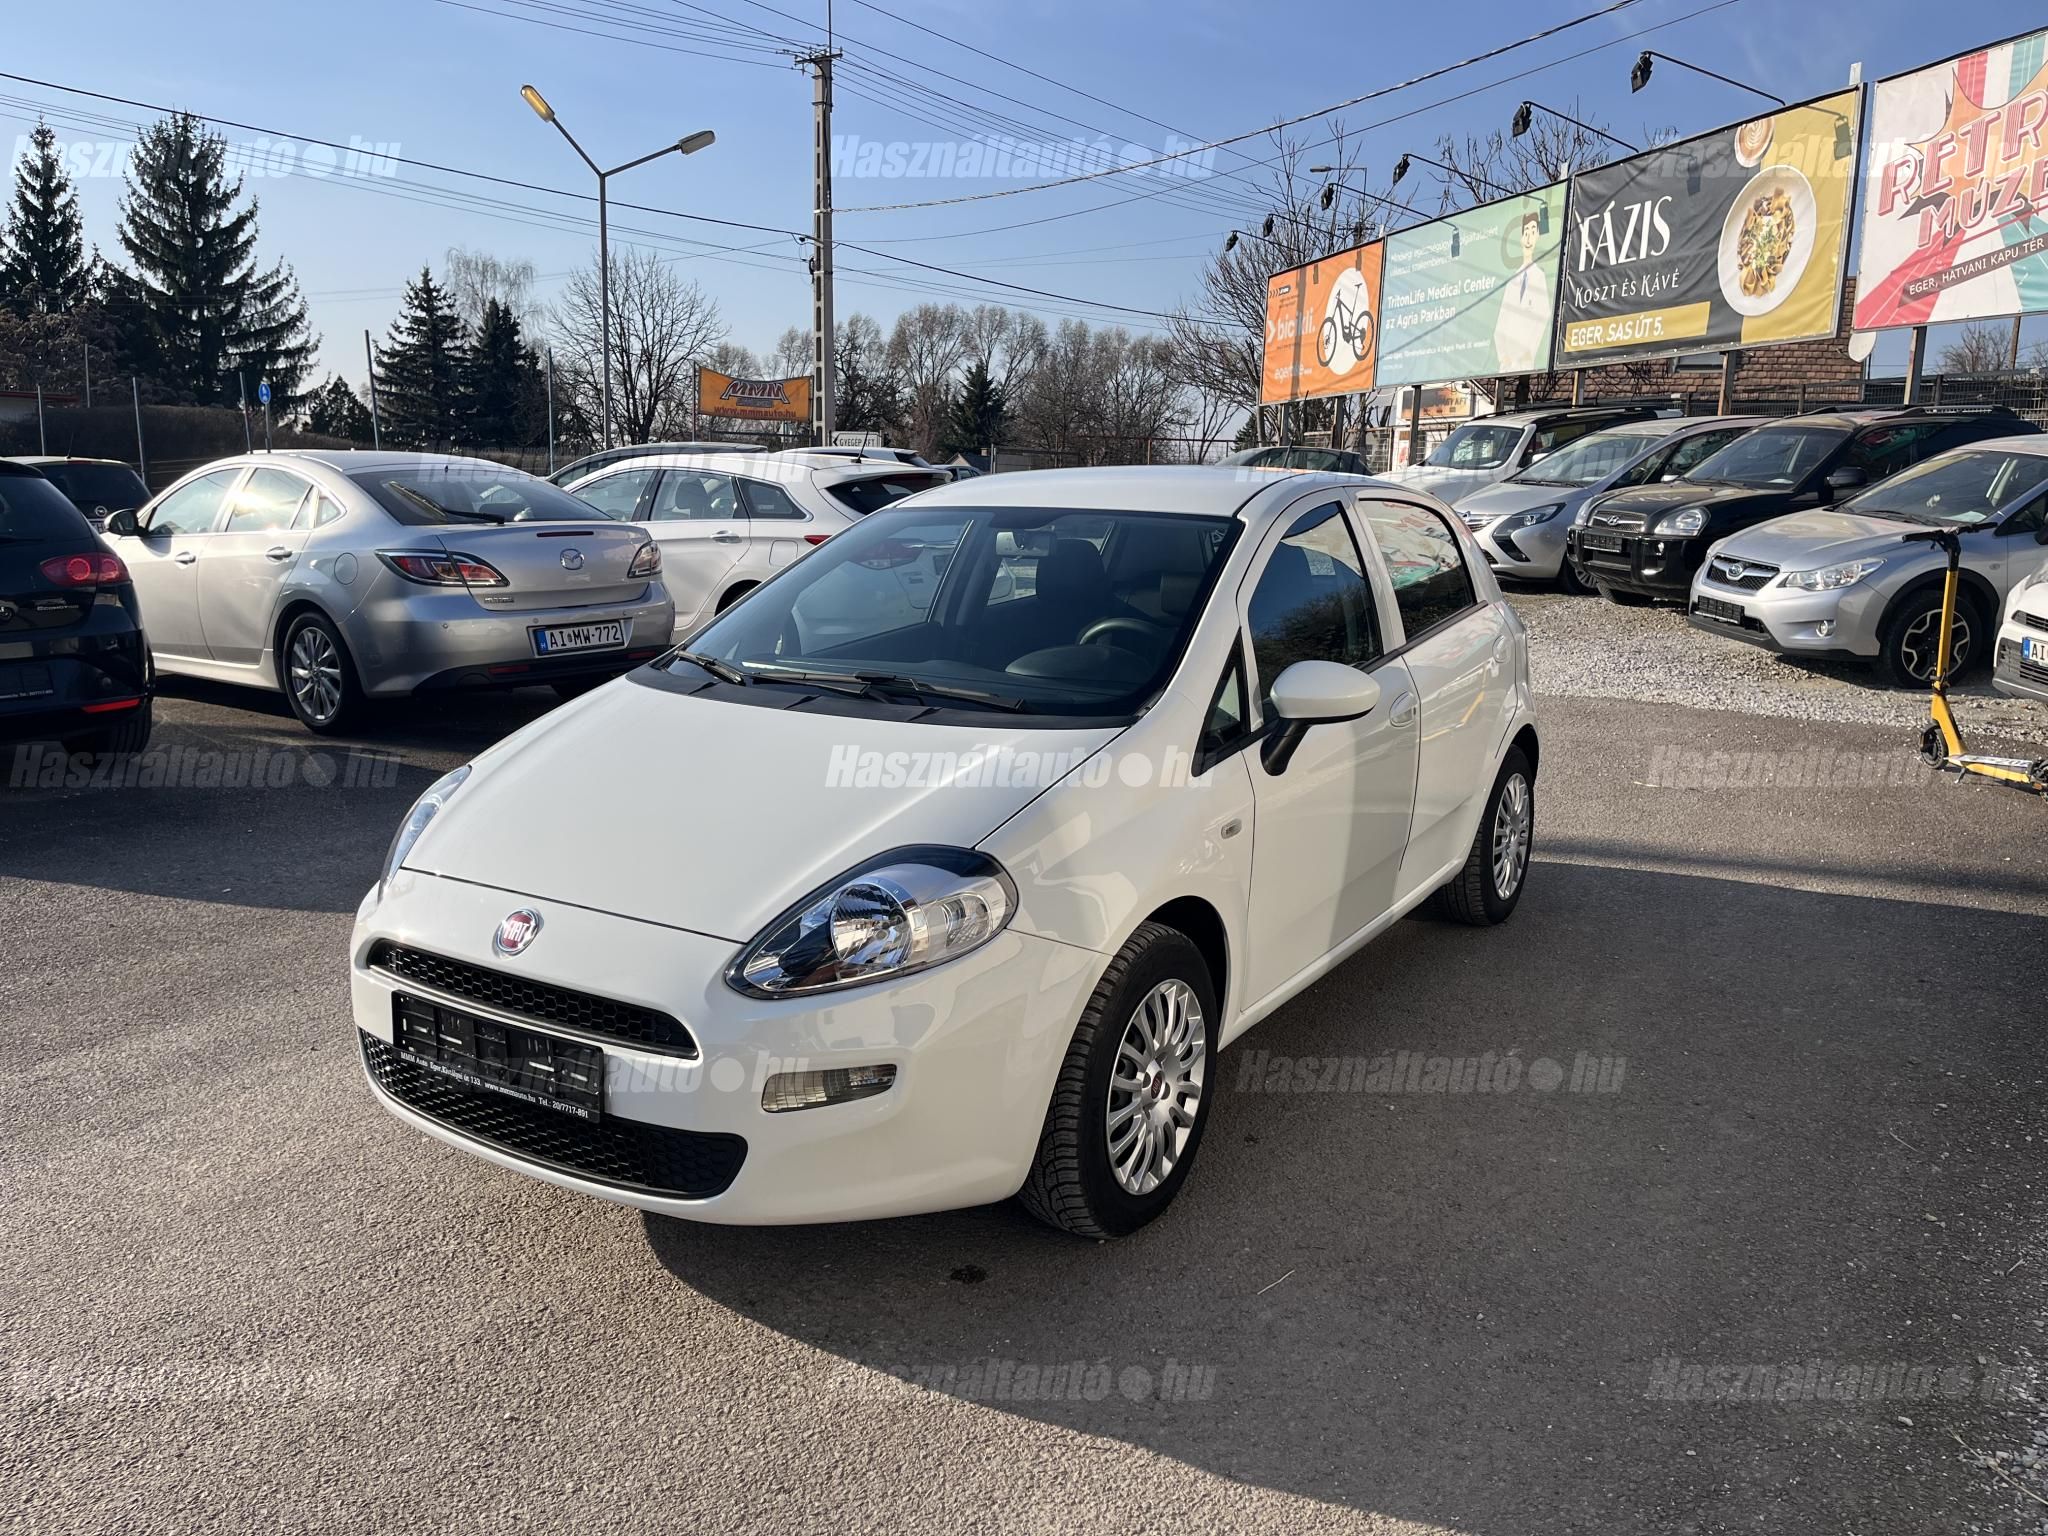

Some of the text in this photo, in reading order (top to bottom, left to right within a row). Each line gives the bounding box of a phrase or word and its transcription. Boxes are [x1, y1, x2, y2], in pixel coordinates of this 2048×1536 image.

[1575, 195, 1672, 272] FÁZIS
[1909, 236, 2045, 295] EGER, HATVANI KAPU TÉR
[1388, 275, 1496, 309] TritonLife Medical Center
[1575, 268, 1680, 308] KOSZT ÉS KÁVÉ
[1385, 305, 1456, 329] az Agria Parkban
[1570, 314, 1664, 346] EGER, SAS ÚT 5.
[720, 380, 790, 404] MMM
[714, 405, 796, 418] www.mmmauto.hu
[550, 625, 620, 649] AI MW-772
[2032, 643, 2045, 660] AI
[400, 1051, 415, 1063] MMM
[416, 1056, 428, 1067] Auto
[484, 1082, 536, 1103] www.mmmauto.hu
[552, 1100, 588, 1119] 20/7717-891
